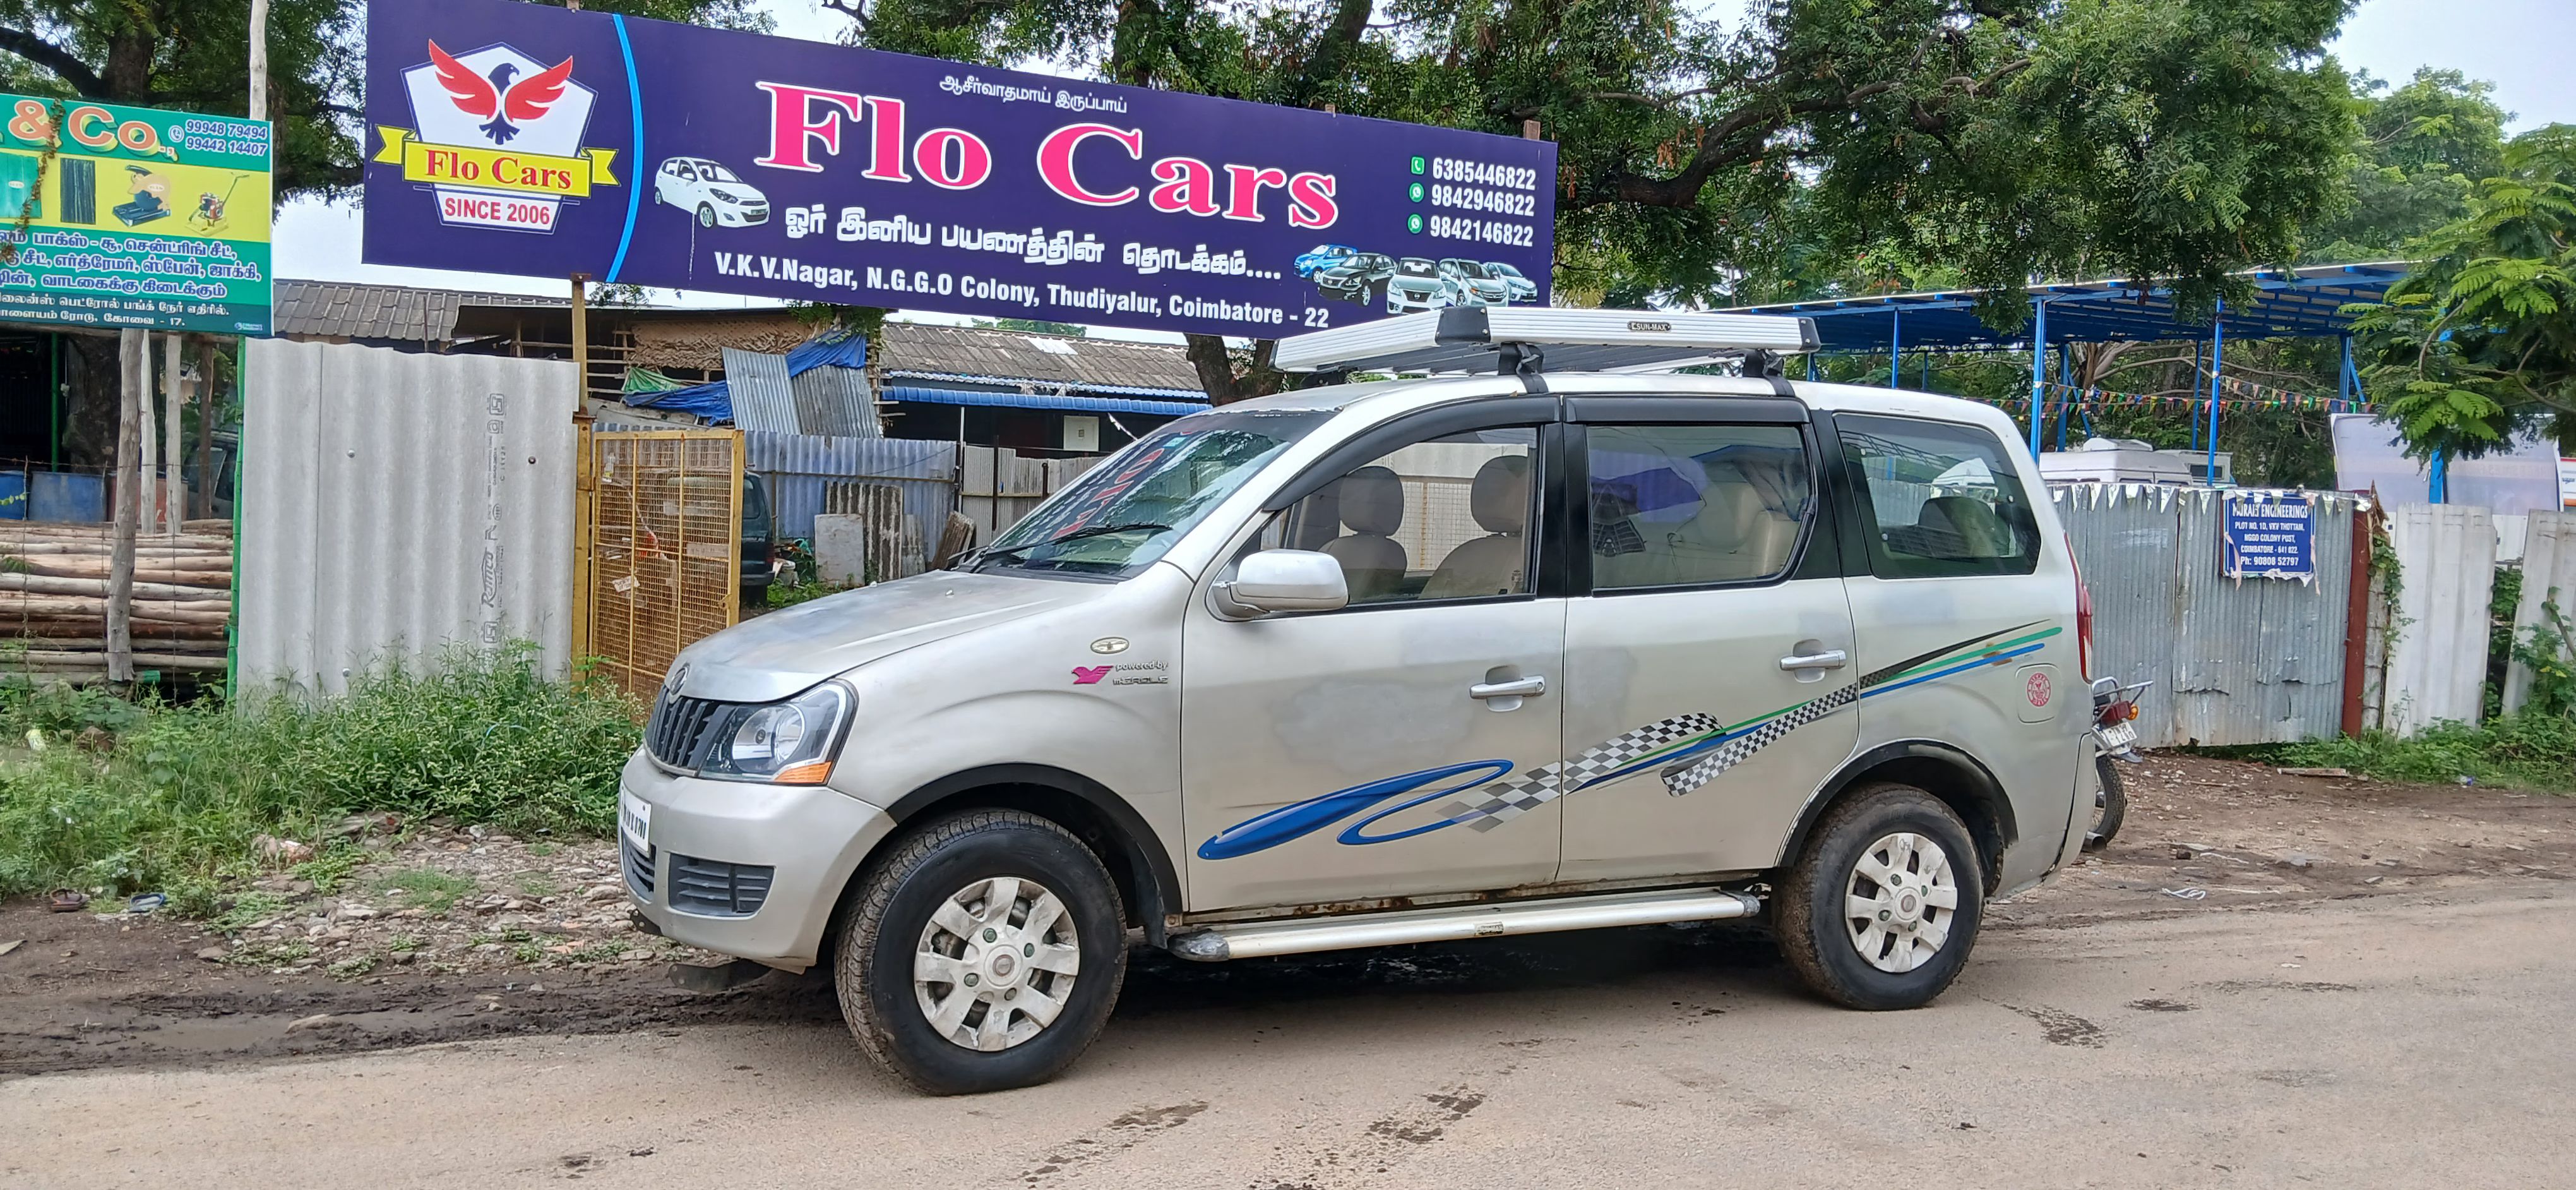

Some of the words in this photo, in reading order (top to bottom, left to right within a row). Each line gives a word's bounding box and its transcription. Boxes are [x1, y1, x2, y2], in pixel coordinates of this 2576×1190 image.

[939, 75, 1051, 103] ஆசீர்வாதமாய்
[1054, 90, 1127, 114] இருப்பாய்
[186, 120, 225, 136] 99948
[228, 122, 266, 139] 79494
[186, 137, 225, 152] 99442
[229, 140, 267, 156] 14407
[753, 80, 992, 190] Flo
[1037, 123, 1339, 229] Cars
[425, 149, 480, 180] Flo
[491, 157, 571, 189] Cars
[1433, 157, 1536, 190] 6385446822
[444, 197, 501, 220] SINCE
[507, 203, 550, 225] 2006
[1431, 184, 1535, 217] 9842946822
[33, 231, 88, 247] பாக்ஸ்
[837, 206, 931, 246] இனிய
[941, 223, 1104, 265] பயணத்தின்
[1430, 215, 1534, 247] 9842146822
[41, 274, 138, 294] வாடகைக்கு
[141, 277, 227, 299] கிடைக்கும்
[714, 251, 859, 291] V.K.V.Nagar,
[866, 266, 953, 296] N.G.G.O
[960, 275, 1039, 308] Colony,
[1047, 283, 1162, 318] Thudiyalur,
[1169, 295, 1283, 325] Coimbatore
[1304, 307, 1329, 328] 22
[2235, 521, 2248, 529] PLOT
[2241, 544, 2274, 553] COIMBATORE
[2277, 557, 2298, 566] 52797
